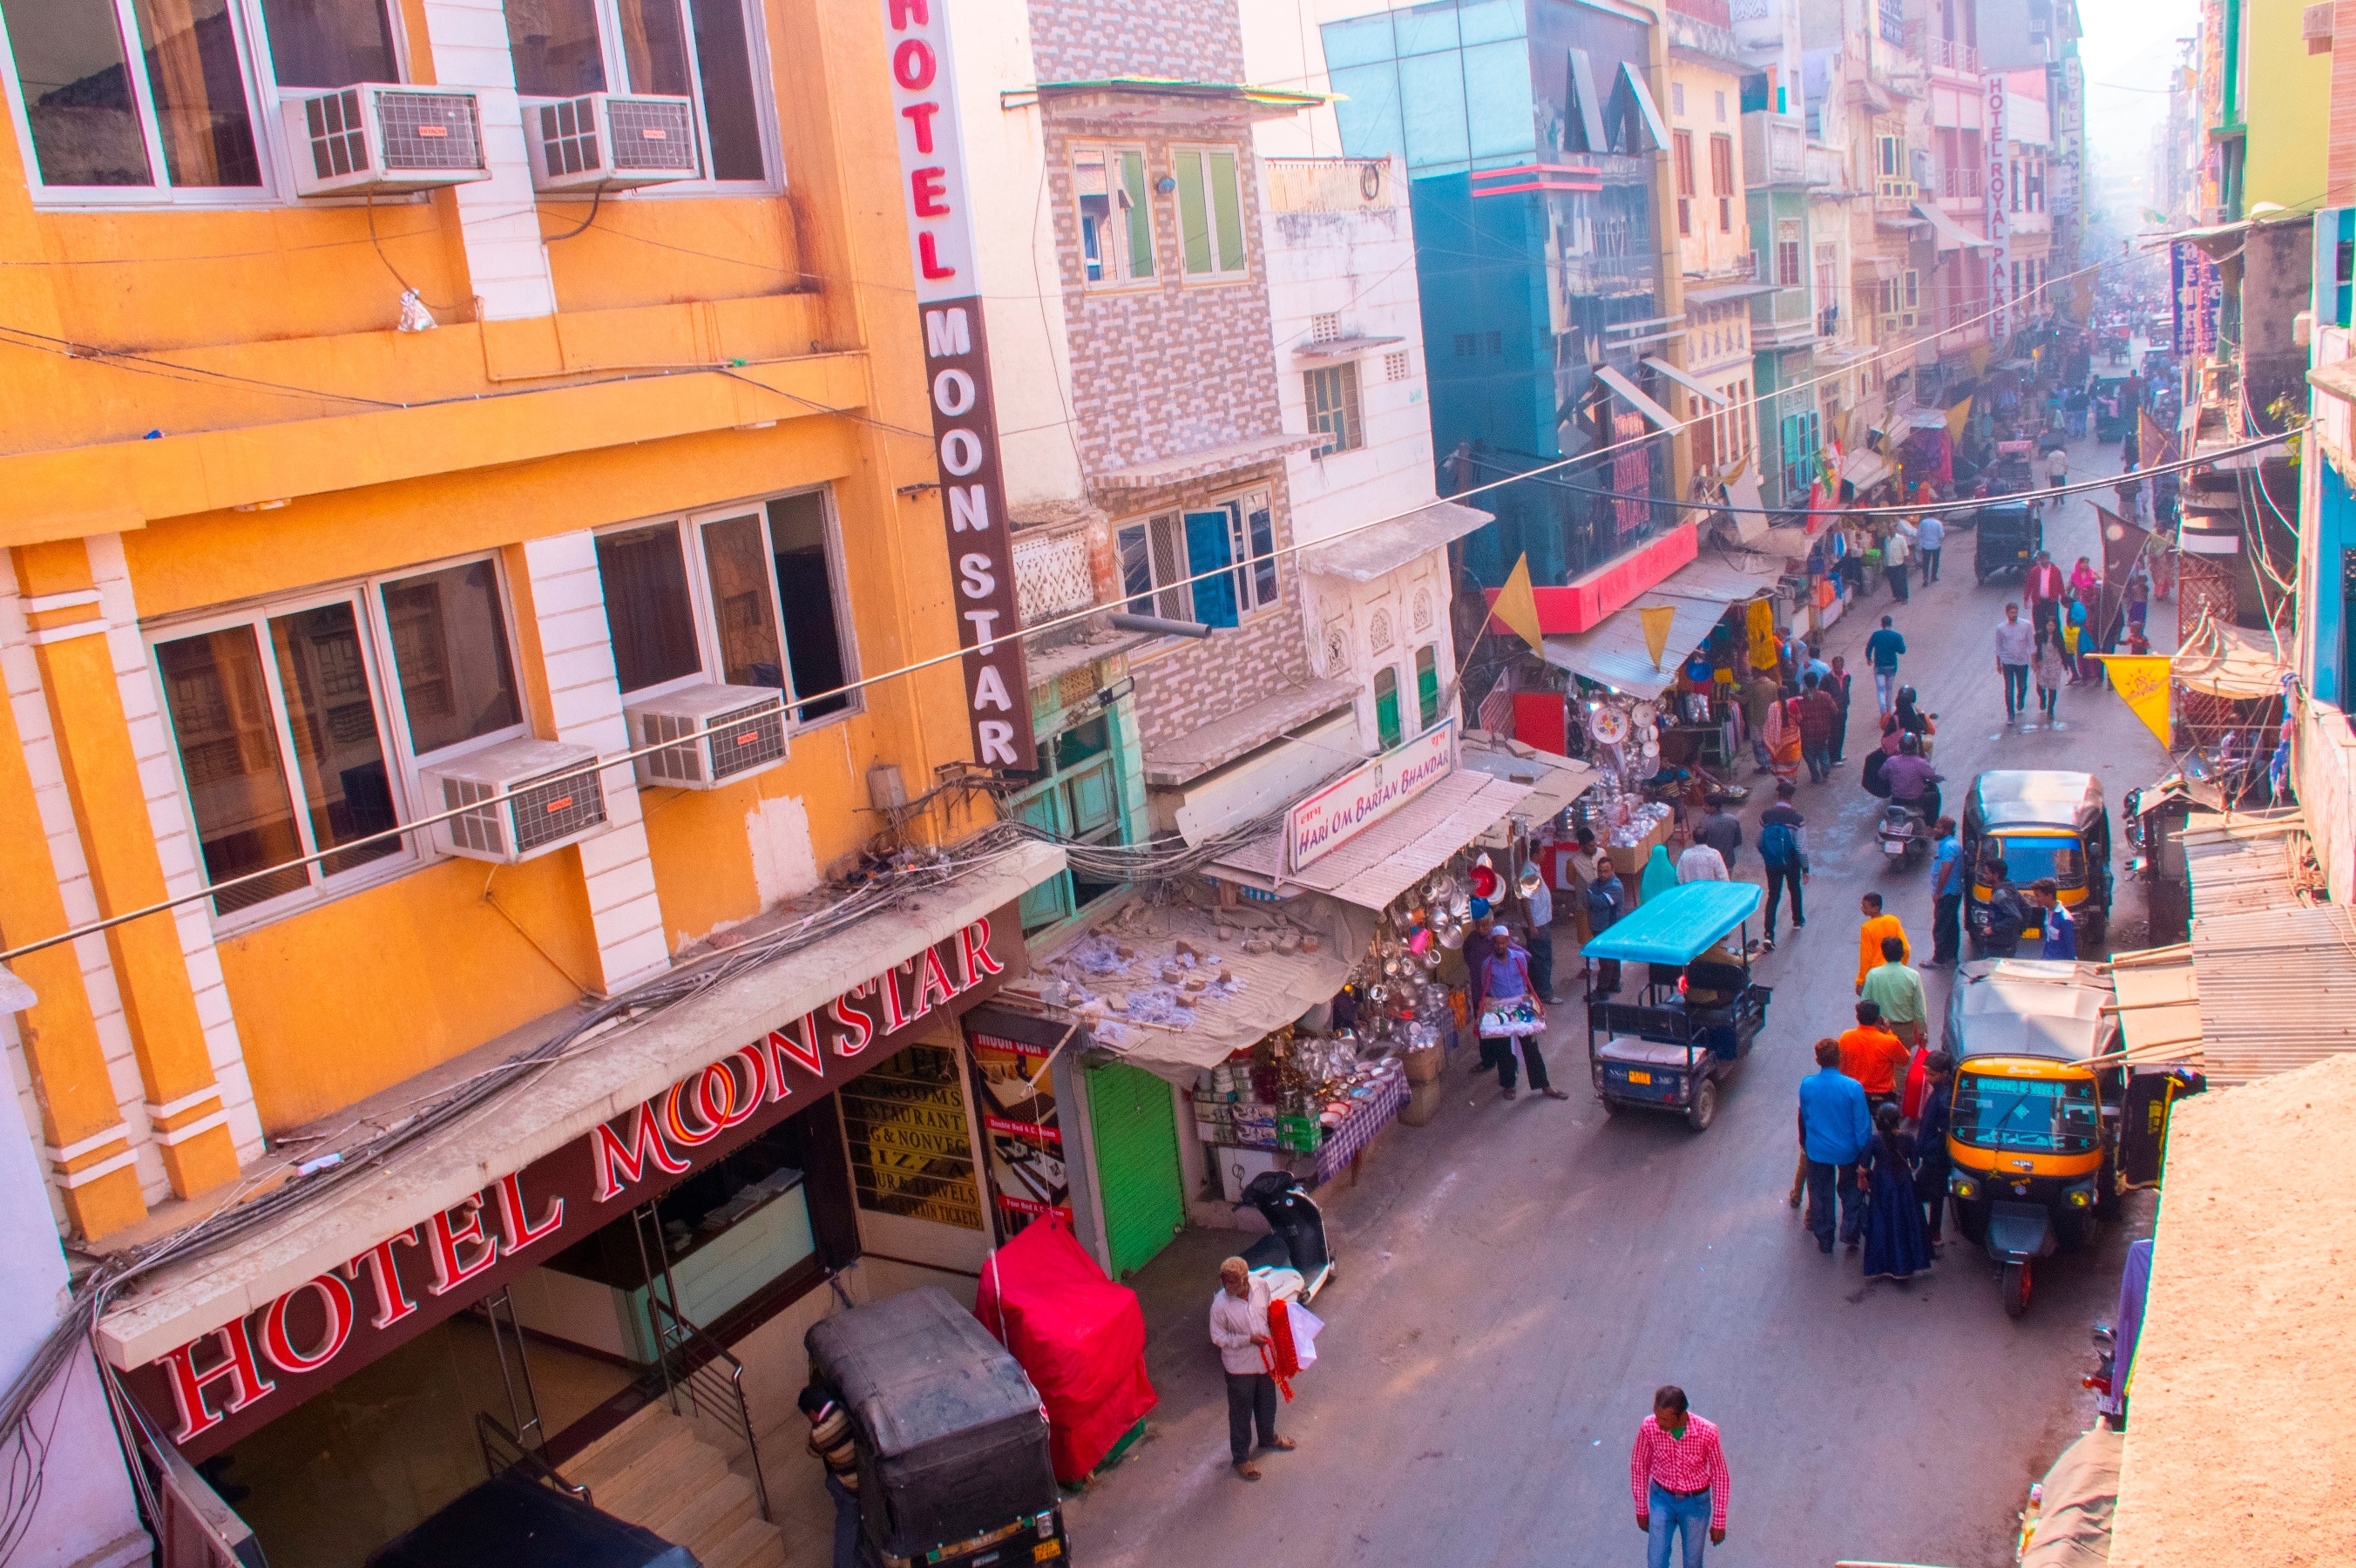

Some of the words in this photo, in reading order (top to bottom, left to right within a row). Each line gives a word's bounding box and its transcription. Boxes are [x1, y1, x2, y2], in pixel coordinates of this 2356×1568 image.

[1989, 78, 2003, 158] HOTEL
[1990, 162, 2005, 240] ROYAL
[1992, 247, 2006, 337] PALACE
[925, 308, 989, 532] MOON
[960, 553, 1018, 765] STAR
[1332, 808, 1352, 834] OM
[1357, 779, 1398, 823] BARTAN
[1401, 749, 1448, 794] BHANDAR
[855, 1145, 966, 1178] PIZZA
[897, 1130, 965, 1156] NONVEG
[990, 1119, 1011, 1131] Double
[1012, 1123, 1024, 1132] Bed
[159, 1167, 564, 1444] HOTEL
[591, 1009, 825, 1202] MOON
[832, 915, 1005, 1058] STAR
[915, 1179, 977, 1205] TRAVELS
[938, 1205, 980, 1227] TICKETS
